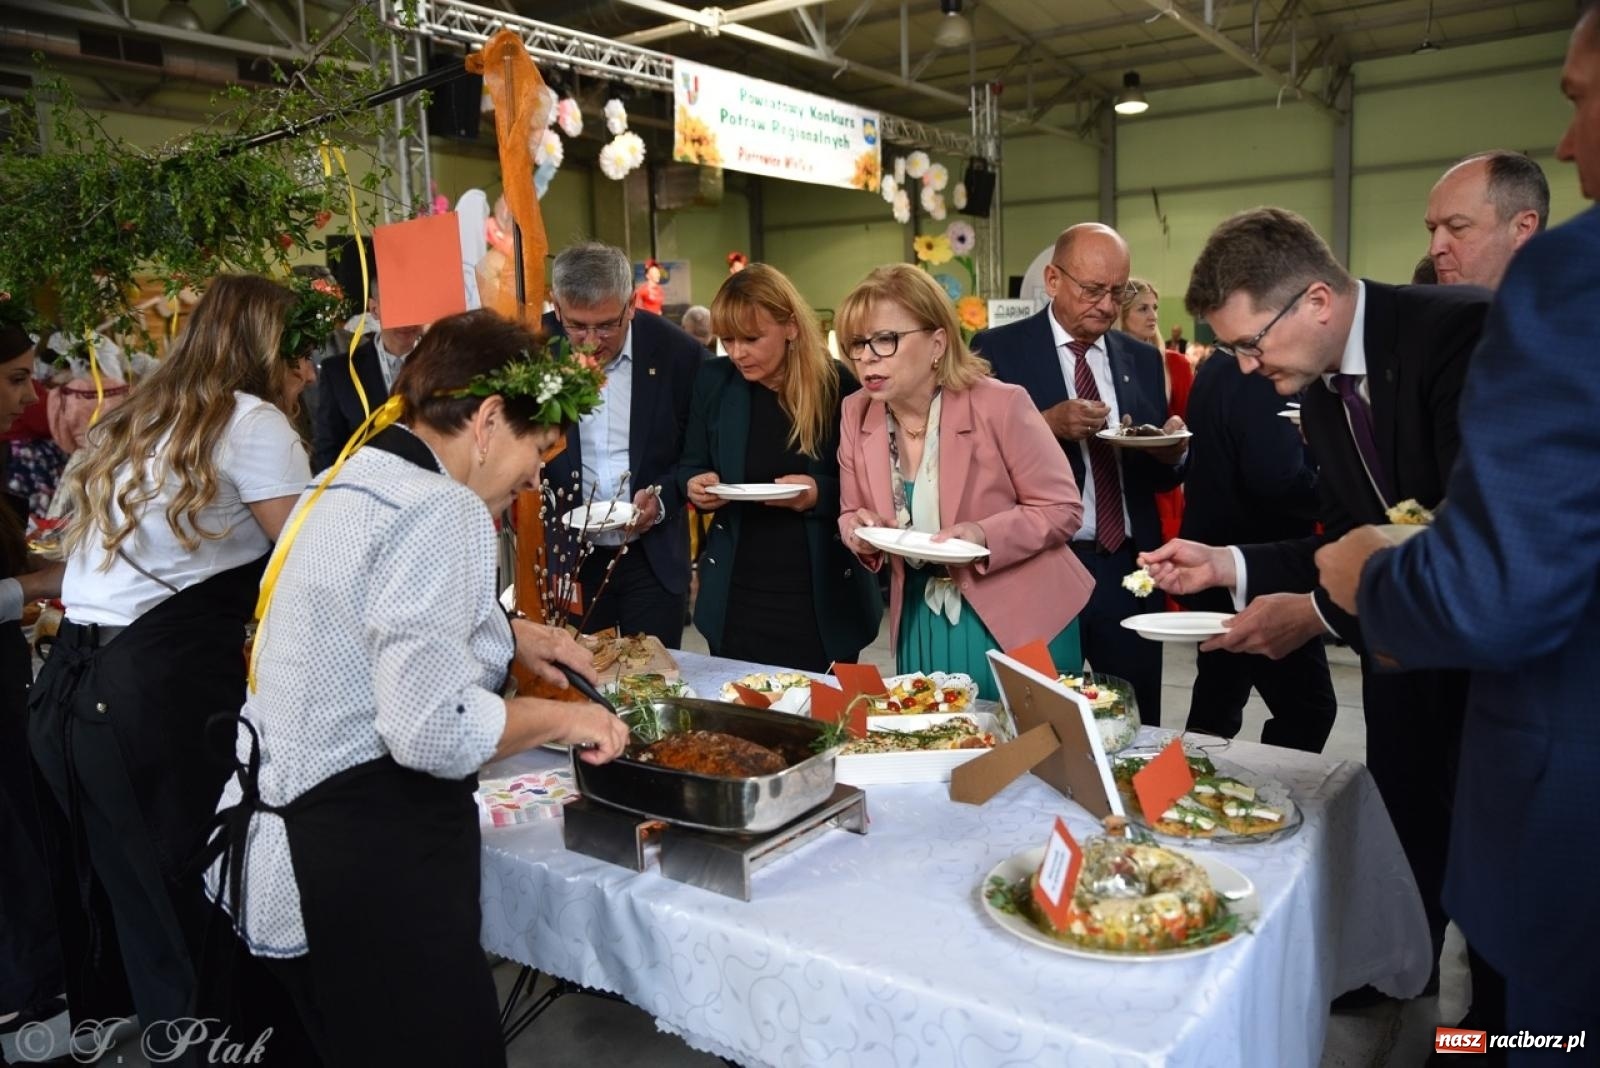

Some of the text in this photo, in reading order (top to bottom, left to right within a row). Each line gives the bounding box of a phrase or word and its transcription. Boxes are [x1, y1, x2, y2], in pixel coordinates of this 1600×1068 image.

[719, 106, 851, 150] Potraw Regionalnych
[809, 106, 856, 129] Konkurs
